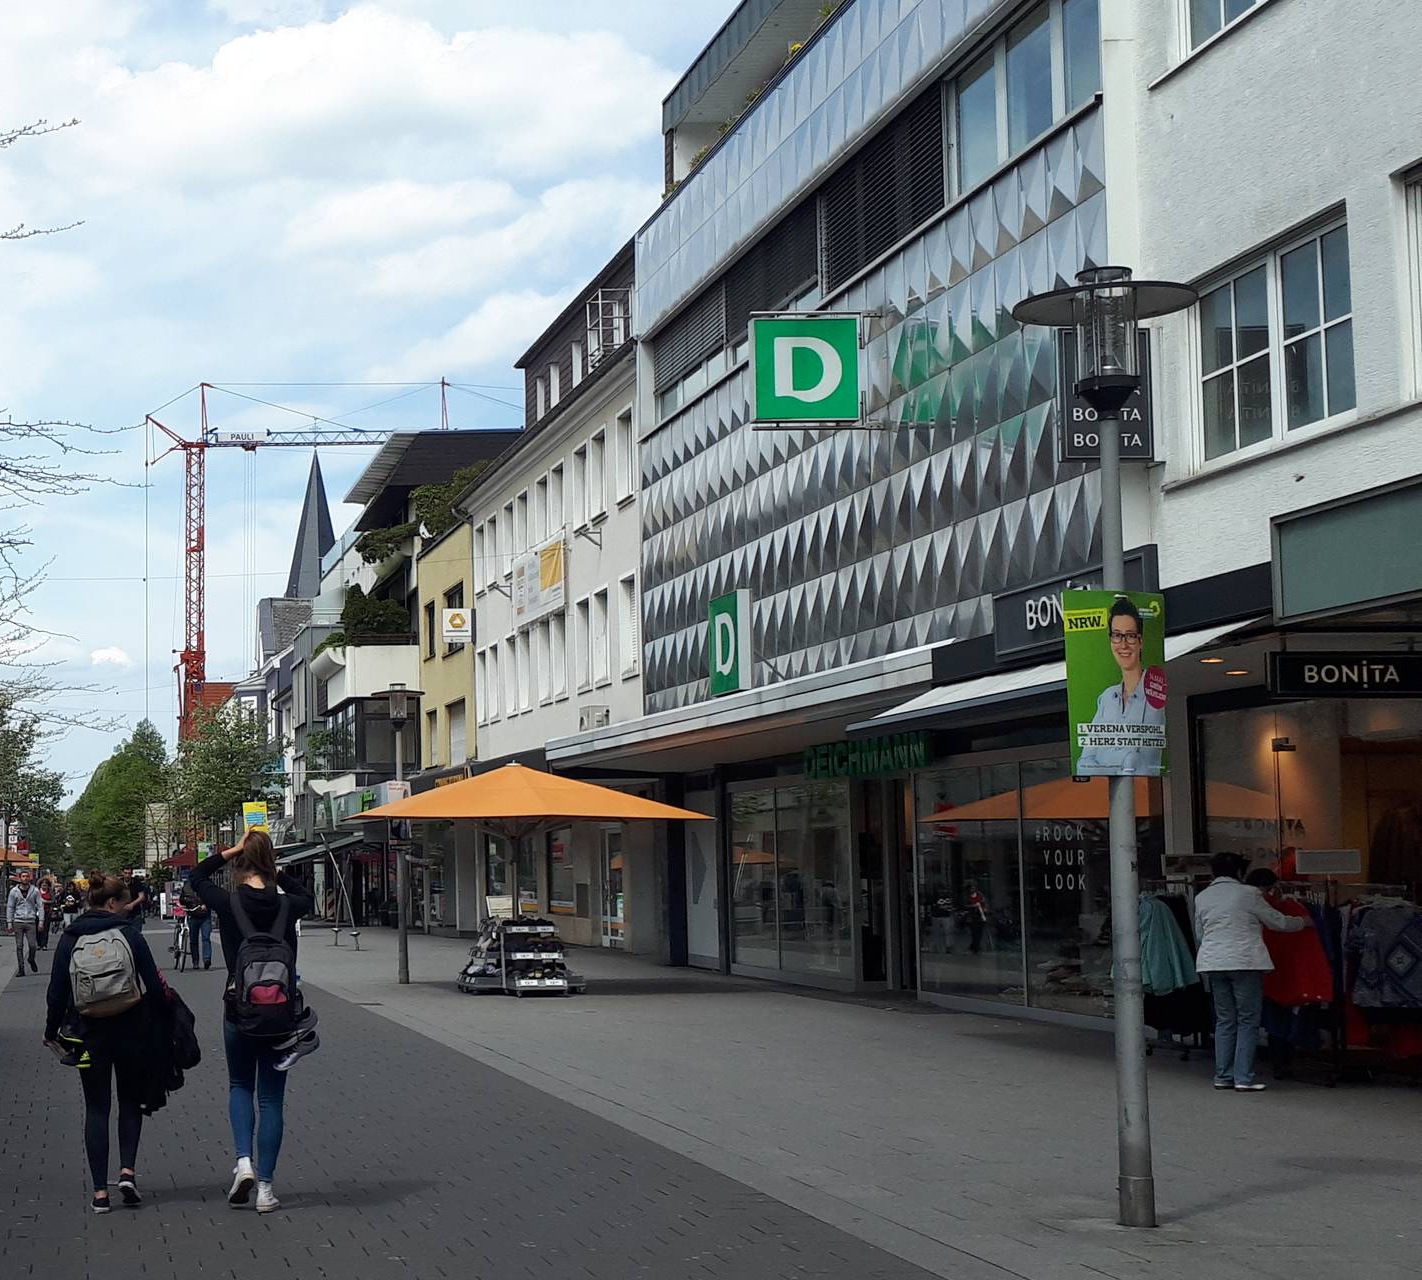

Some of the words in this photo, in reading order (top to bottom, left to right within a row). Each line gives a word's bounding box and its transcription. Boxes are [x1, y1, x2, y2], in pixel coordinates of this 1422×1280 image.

[774, 336, 843, 403] D
[1073, 407, 1142, 422] BOTA
[230, 433, 255, 441] PAULI
[1073, 433, 1143, 447] BOTA
[1068, 616, 1105, 630] NRW.
[715, 612, 735, 676] D
[1303, 659, 1401, 689] BONITA
[1079, 725, 1086, 733] 1.
[1087, 724, 1126, 733] VERENA
[1090, 738, 1116, 746] HERZ
[1117, 738, 1141, 747] STATT
[802, 740, 928, 779] DEICHMANN
[1042, 824, 1084, 841] ROCK
[1042, 849, 1085, 866] YOUR
[1044, 873, 1086, 890] LOOK
